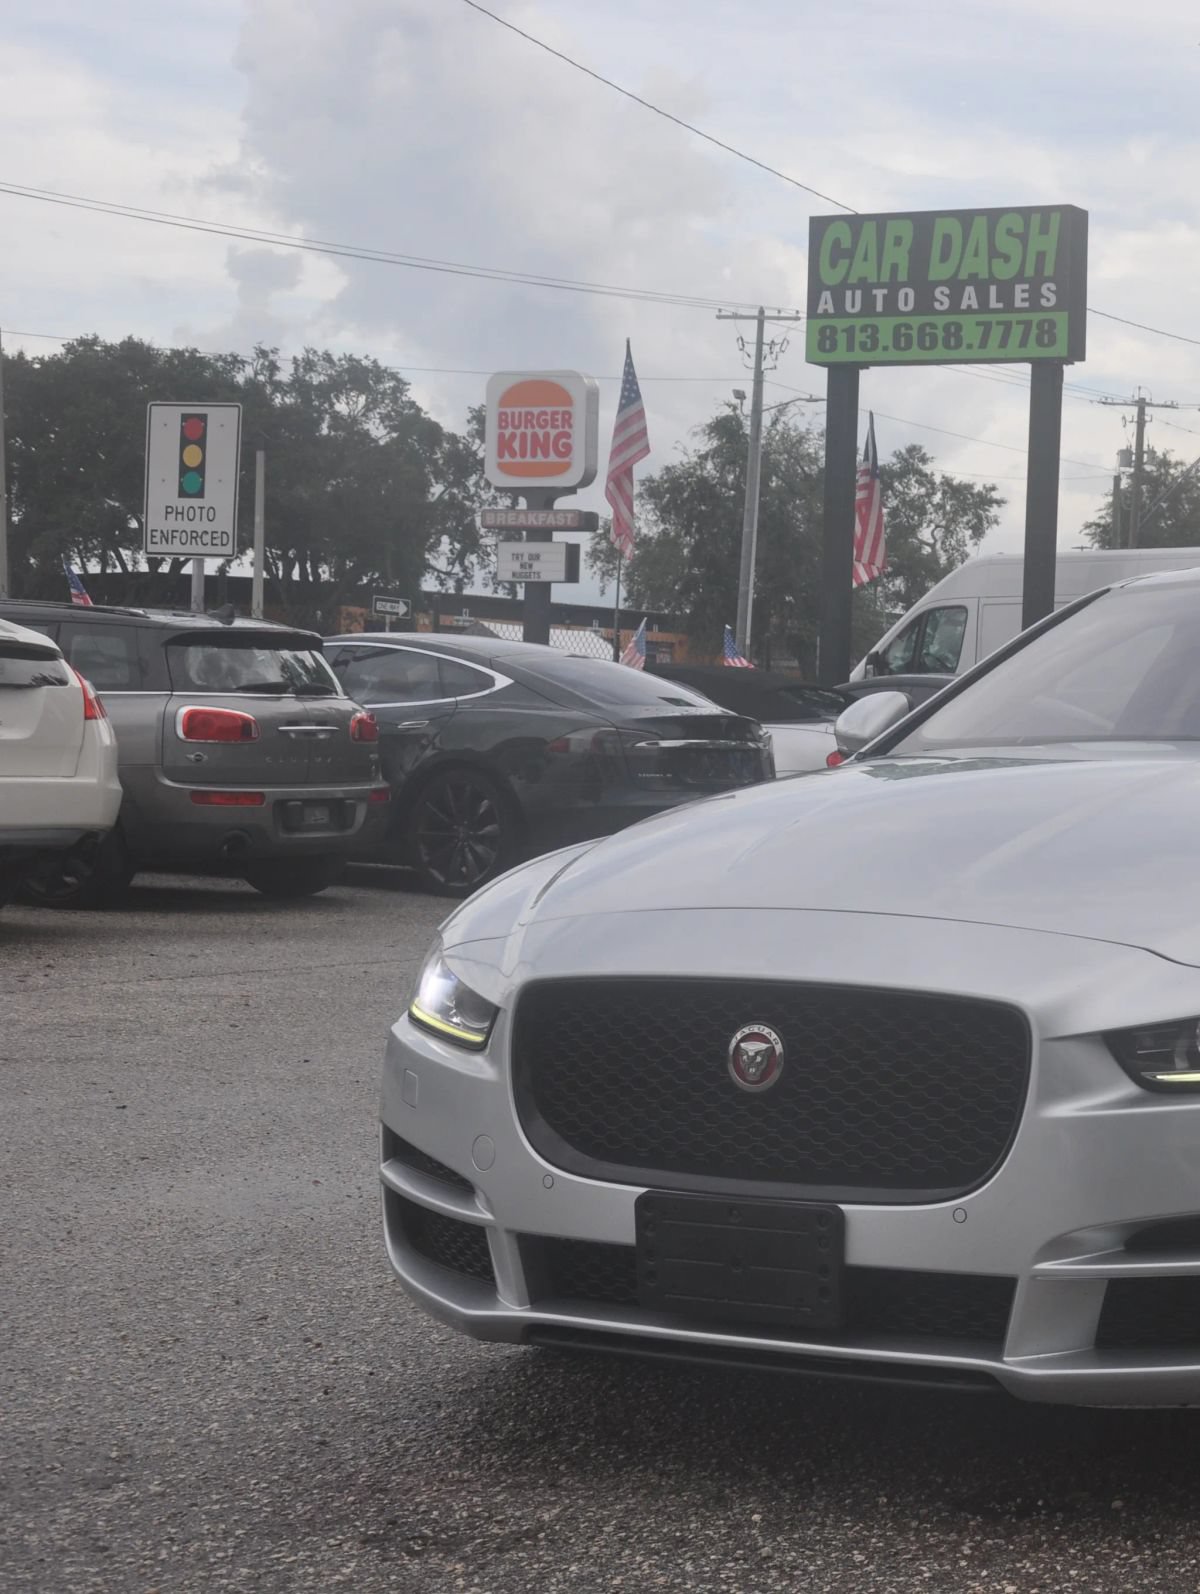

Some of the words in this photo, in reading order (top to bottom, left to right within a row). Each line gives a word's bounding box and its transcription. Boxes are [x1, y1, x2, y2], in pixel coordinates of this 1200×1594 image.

[818, 219, 914, 286] CAR
[927, 212, 1061, 281] DASH
[816, 287, 915, 314] AUTO
[933, 282, 1058, 311] SALES
[816, 318, 1058, 353] 813.668.7778
[497, 409, 573, 430] BURGER
[496, 431, 573, 460] KING
[164, 505, 216, 522] PHOTO
[485, 512, 575, 526] BREAKFAST
[150, 529, 230, 546] ENFORCED
[511, 552, 524, 561] TRY
[528, 552, 541, 561] OUR
[520, 561, 533, 570] NEW
[511, 571, 541, 579] NUGGETS
[735, 1026, 779, 1046] JAGUAR
